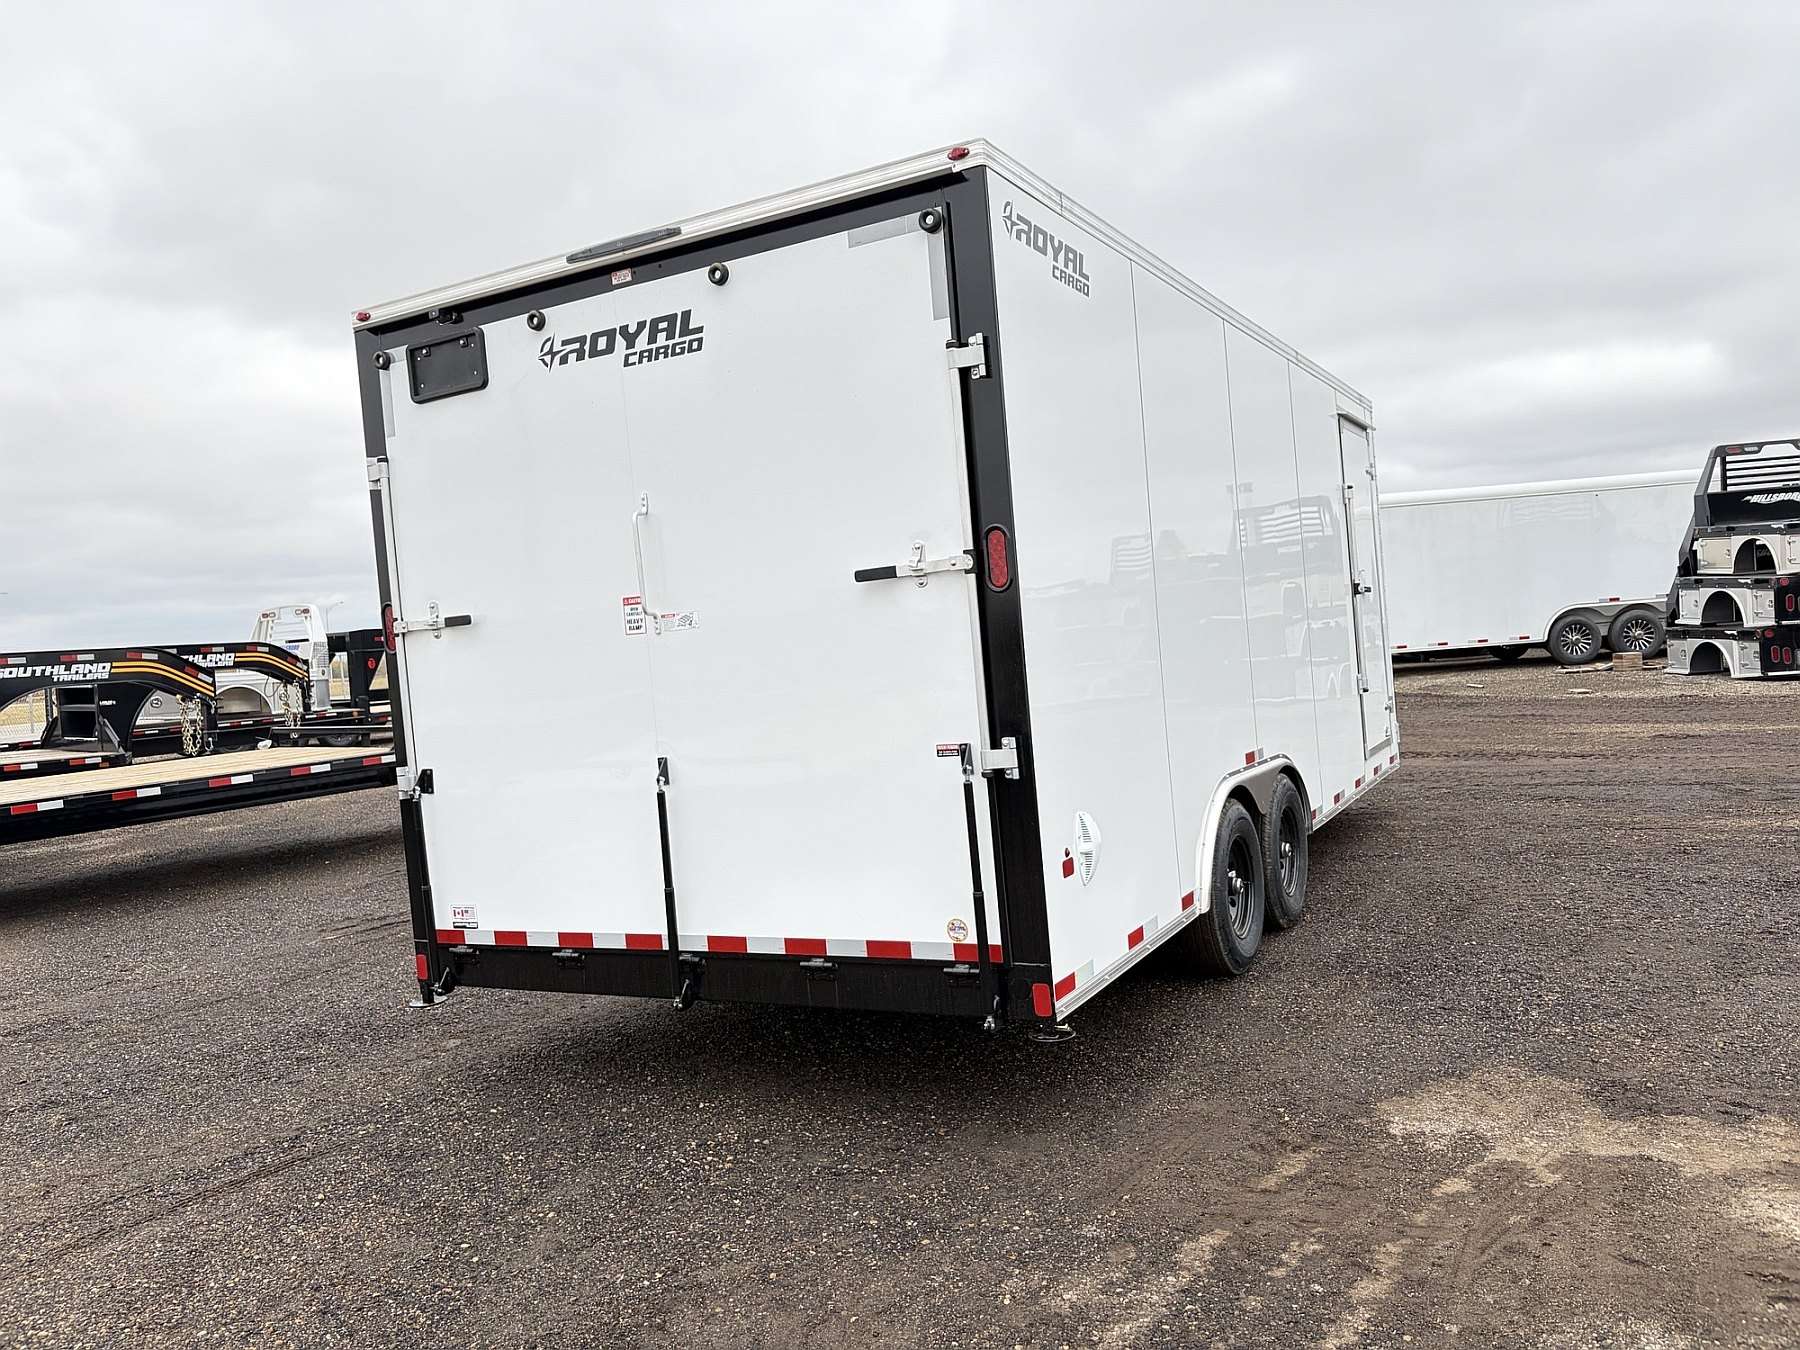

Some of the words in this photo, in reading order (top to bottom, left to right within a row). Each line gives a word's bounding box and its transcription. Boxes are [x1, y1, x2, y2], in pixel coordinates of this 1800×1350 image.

[1016, 213, 1090, 282] ROYAL
[1052, 264, 1090, 298] CARGO
[559, 309, 704, 366] ROYAL
[623, 337, 703, 368] CARGO
[180, 653, 235, 662] HLAND
[52, 672, 109, 682] TRAILERS
